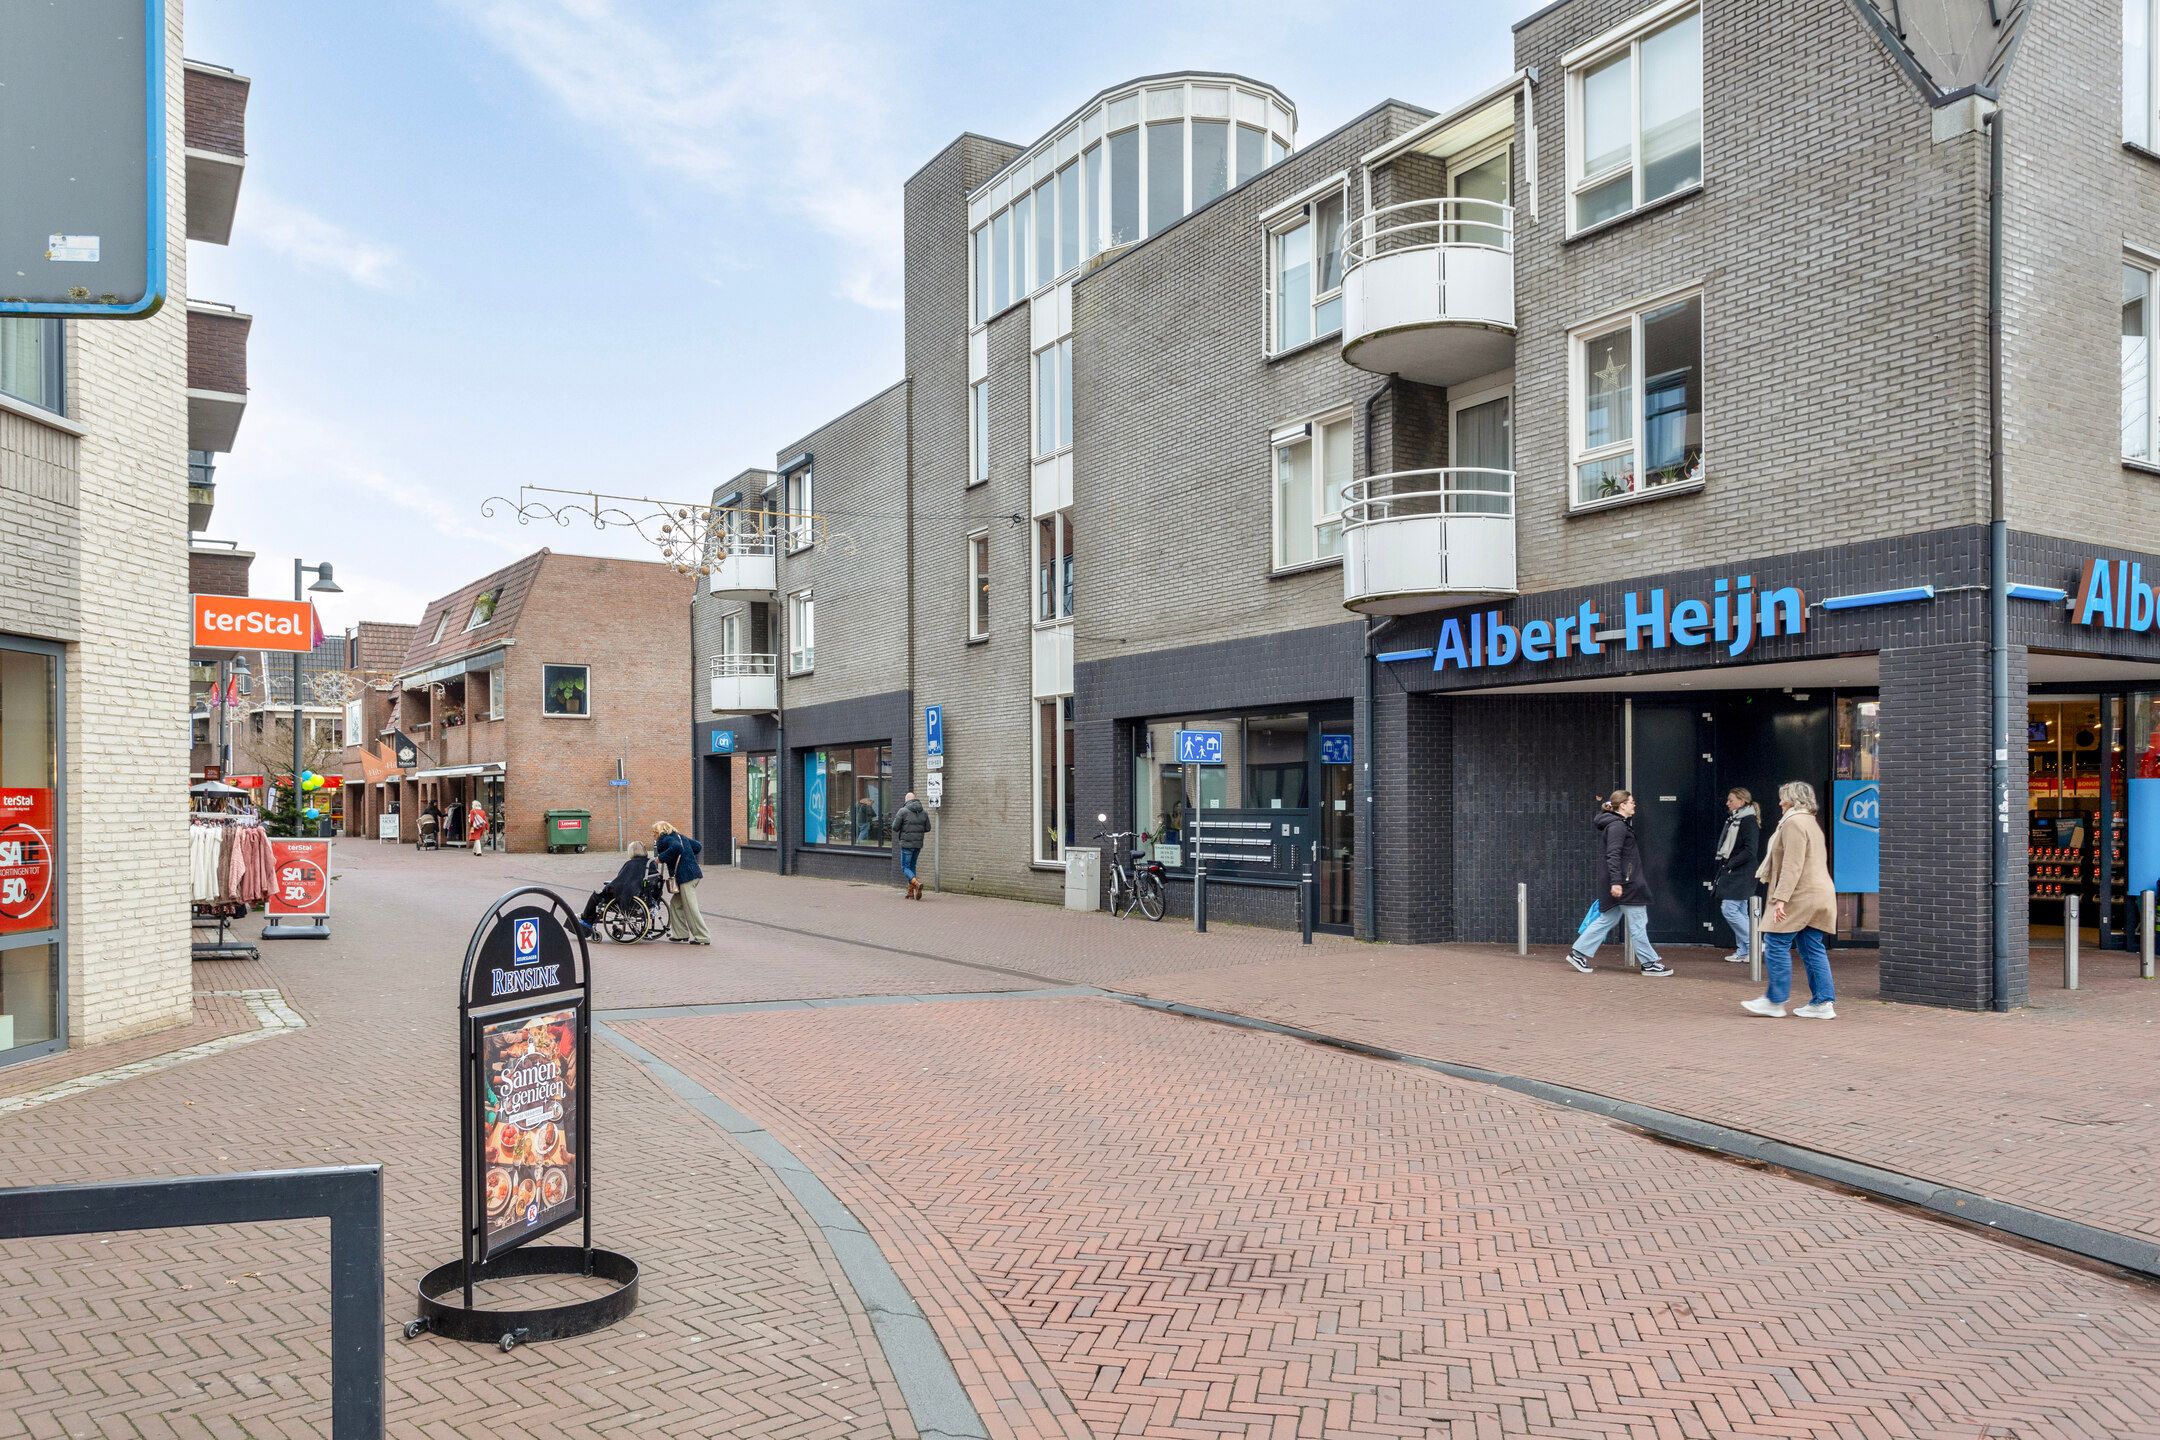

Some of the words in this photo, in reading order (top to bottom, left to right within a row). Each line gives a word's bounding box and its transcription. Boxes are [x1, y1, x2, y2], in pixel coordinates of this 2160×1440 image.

[2073, 558, 2160, 632] Alb
[204, 609, 303, 635] terStal
[1433, 599, 1604, 672] Albert
[1625, 575, 1806, 657] Heijn
[929, 710, 937, 735] P
[3, 795, 34, 806] terStal
[0, 841, 39, 866] SALE
[29, 867, 40, 875] TOT
[282, 867, 316, 881] SALE
[2, 878, 35, 904] 50%
[285, 886, 311, 900] 50%
[520, 931, 533, 949] K
[491, 964, 560, 996] RENSINK
[500, 1061, 557, 1097] Samen
[503, 1081, 566, 1115] genieten
